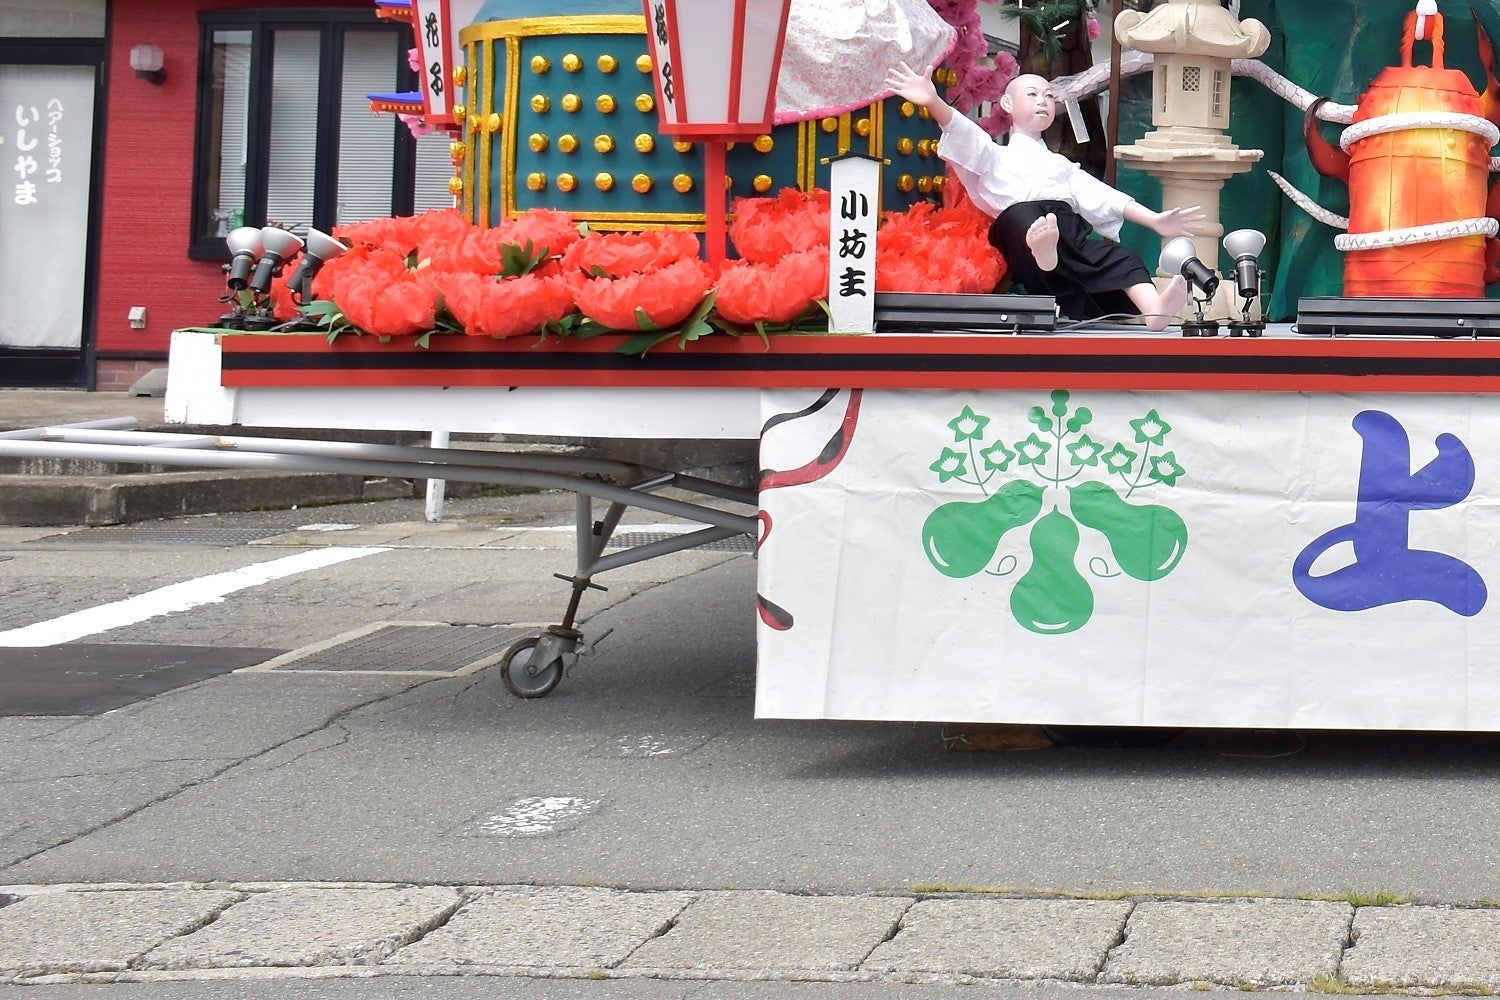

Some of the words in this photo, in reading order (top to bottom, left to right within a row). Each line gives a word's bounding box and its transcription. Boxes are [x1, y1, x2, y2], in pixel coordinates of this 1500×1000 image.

[14, 105, 39, 206] いしやま
[838, 189, 869, 298] 小坊主
